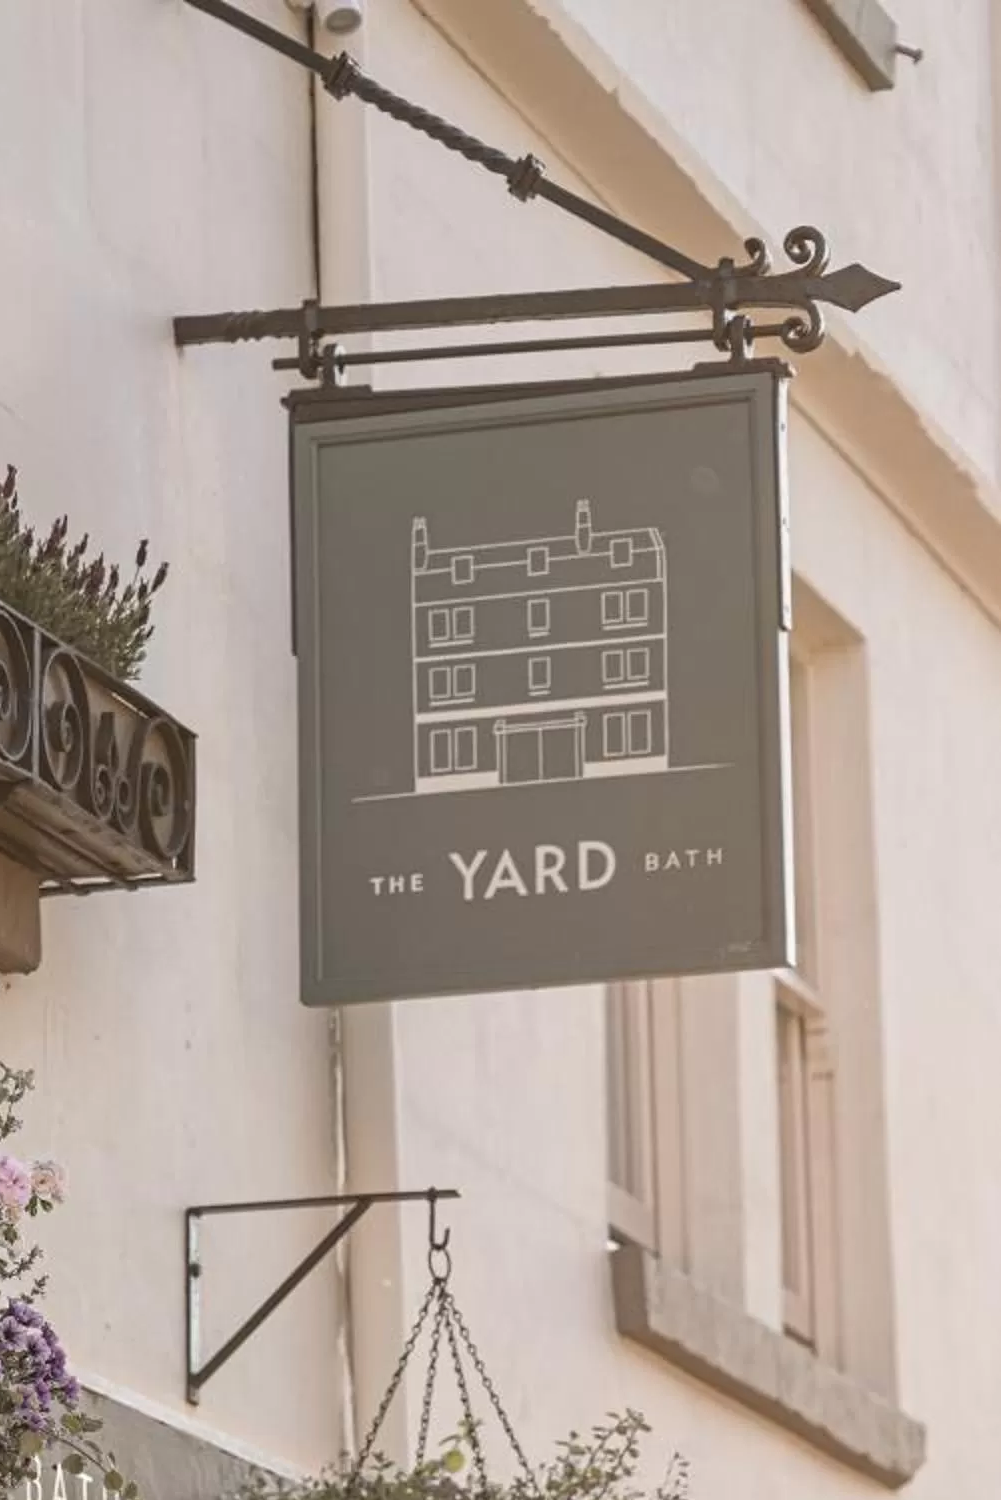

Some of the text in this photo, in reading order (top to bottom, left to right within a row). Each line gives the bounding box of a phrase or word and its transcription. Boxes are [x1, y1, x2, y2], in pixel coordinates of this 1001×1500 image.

[369, 840, 724, 901] THE YARD BATH
